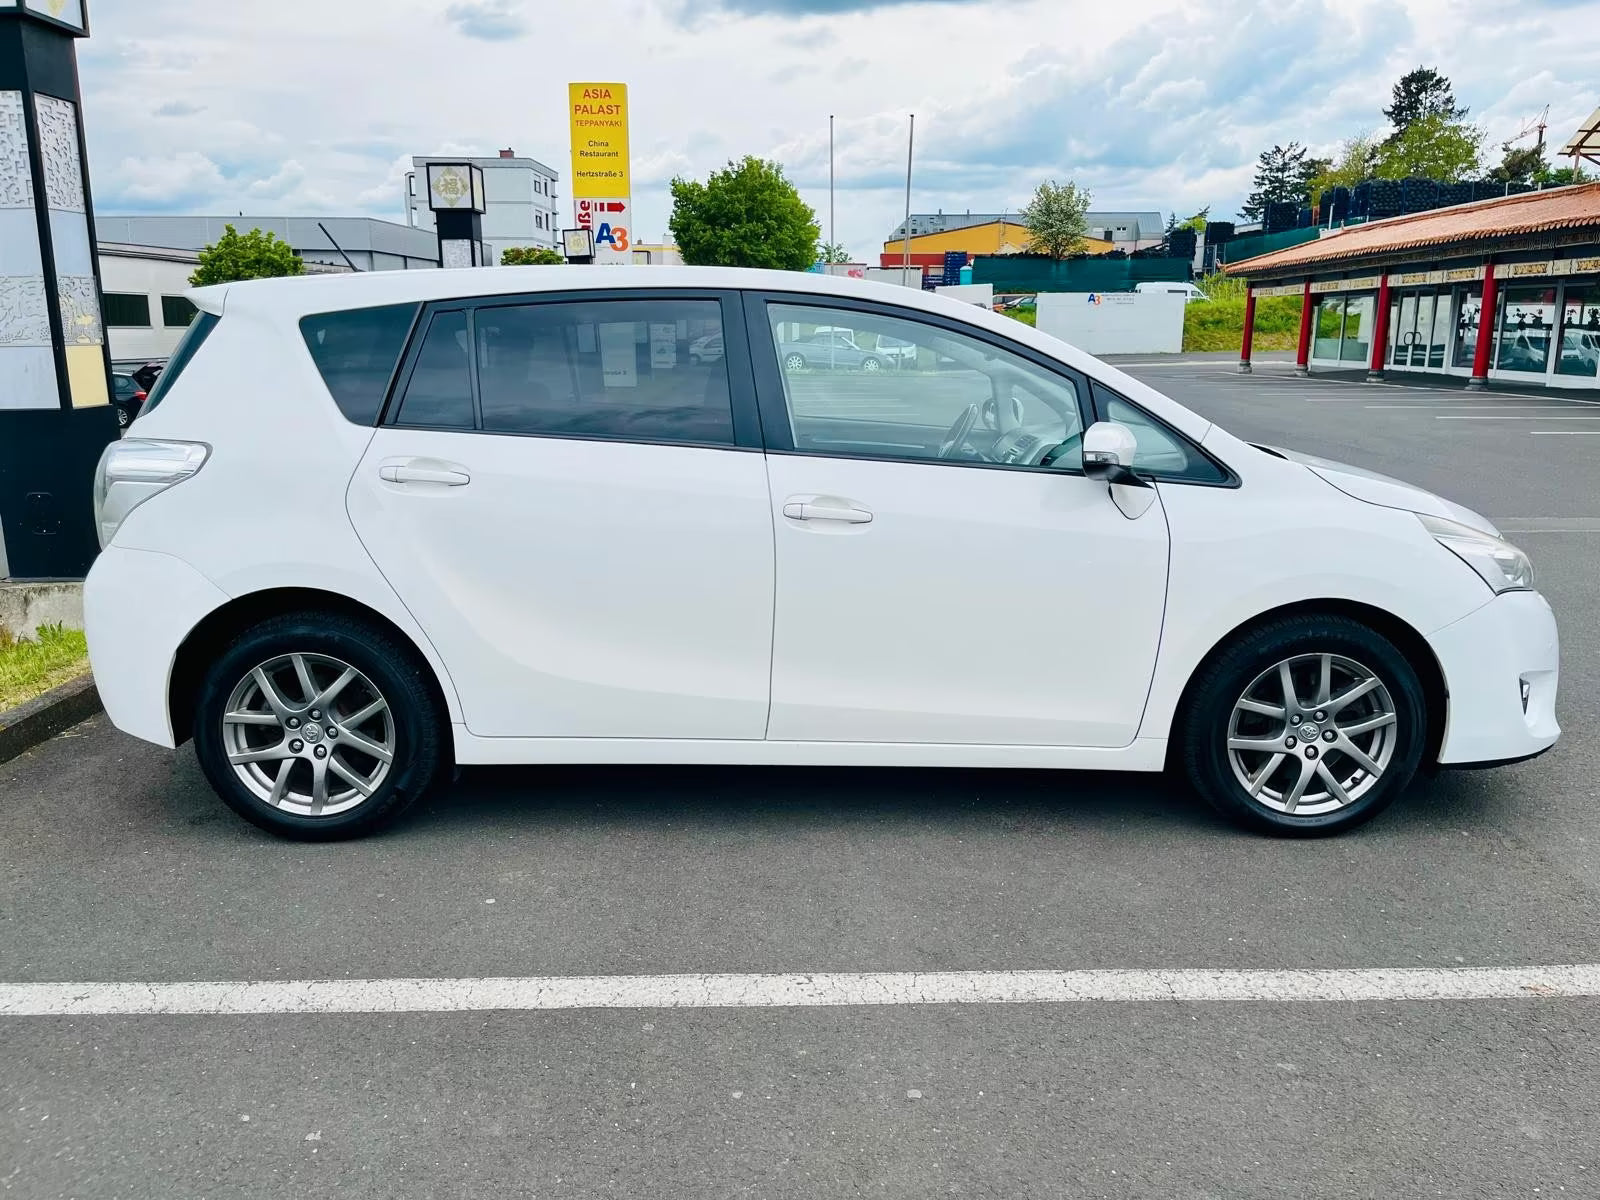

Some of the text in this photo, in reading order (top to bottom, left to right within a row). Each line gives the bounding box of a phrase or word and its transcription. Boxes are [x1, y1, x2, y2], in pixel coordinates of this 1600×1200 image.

[583, 88, 612, 100] ASIA
[574, 104, 621, 115] PALAST
[575, 119, 622, 127] TEPPANYAKI
[579, 150, 619, 158] Restaurant
[576, 170, 624, 178] Hertzstraße 3
[595, 222, 629, 252] A3
[1088, 293, 1101, 305] A3
